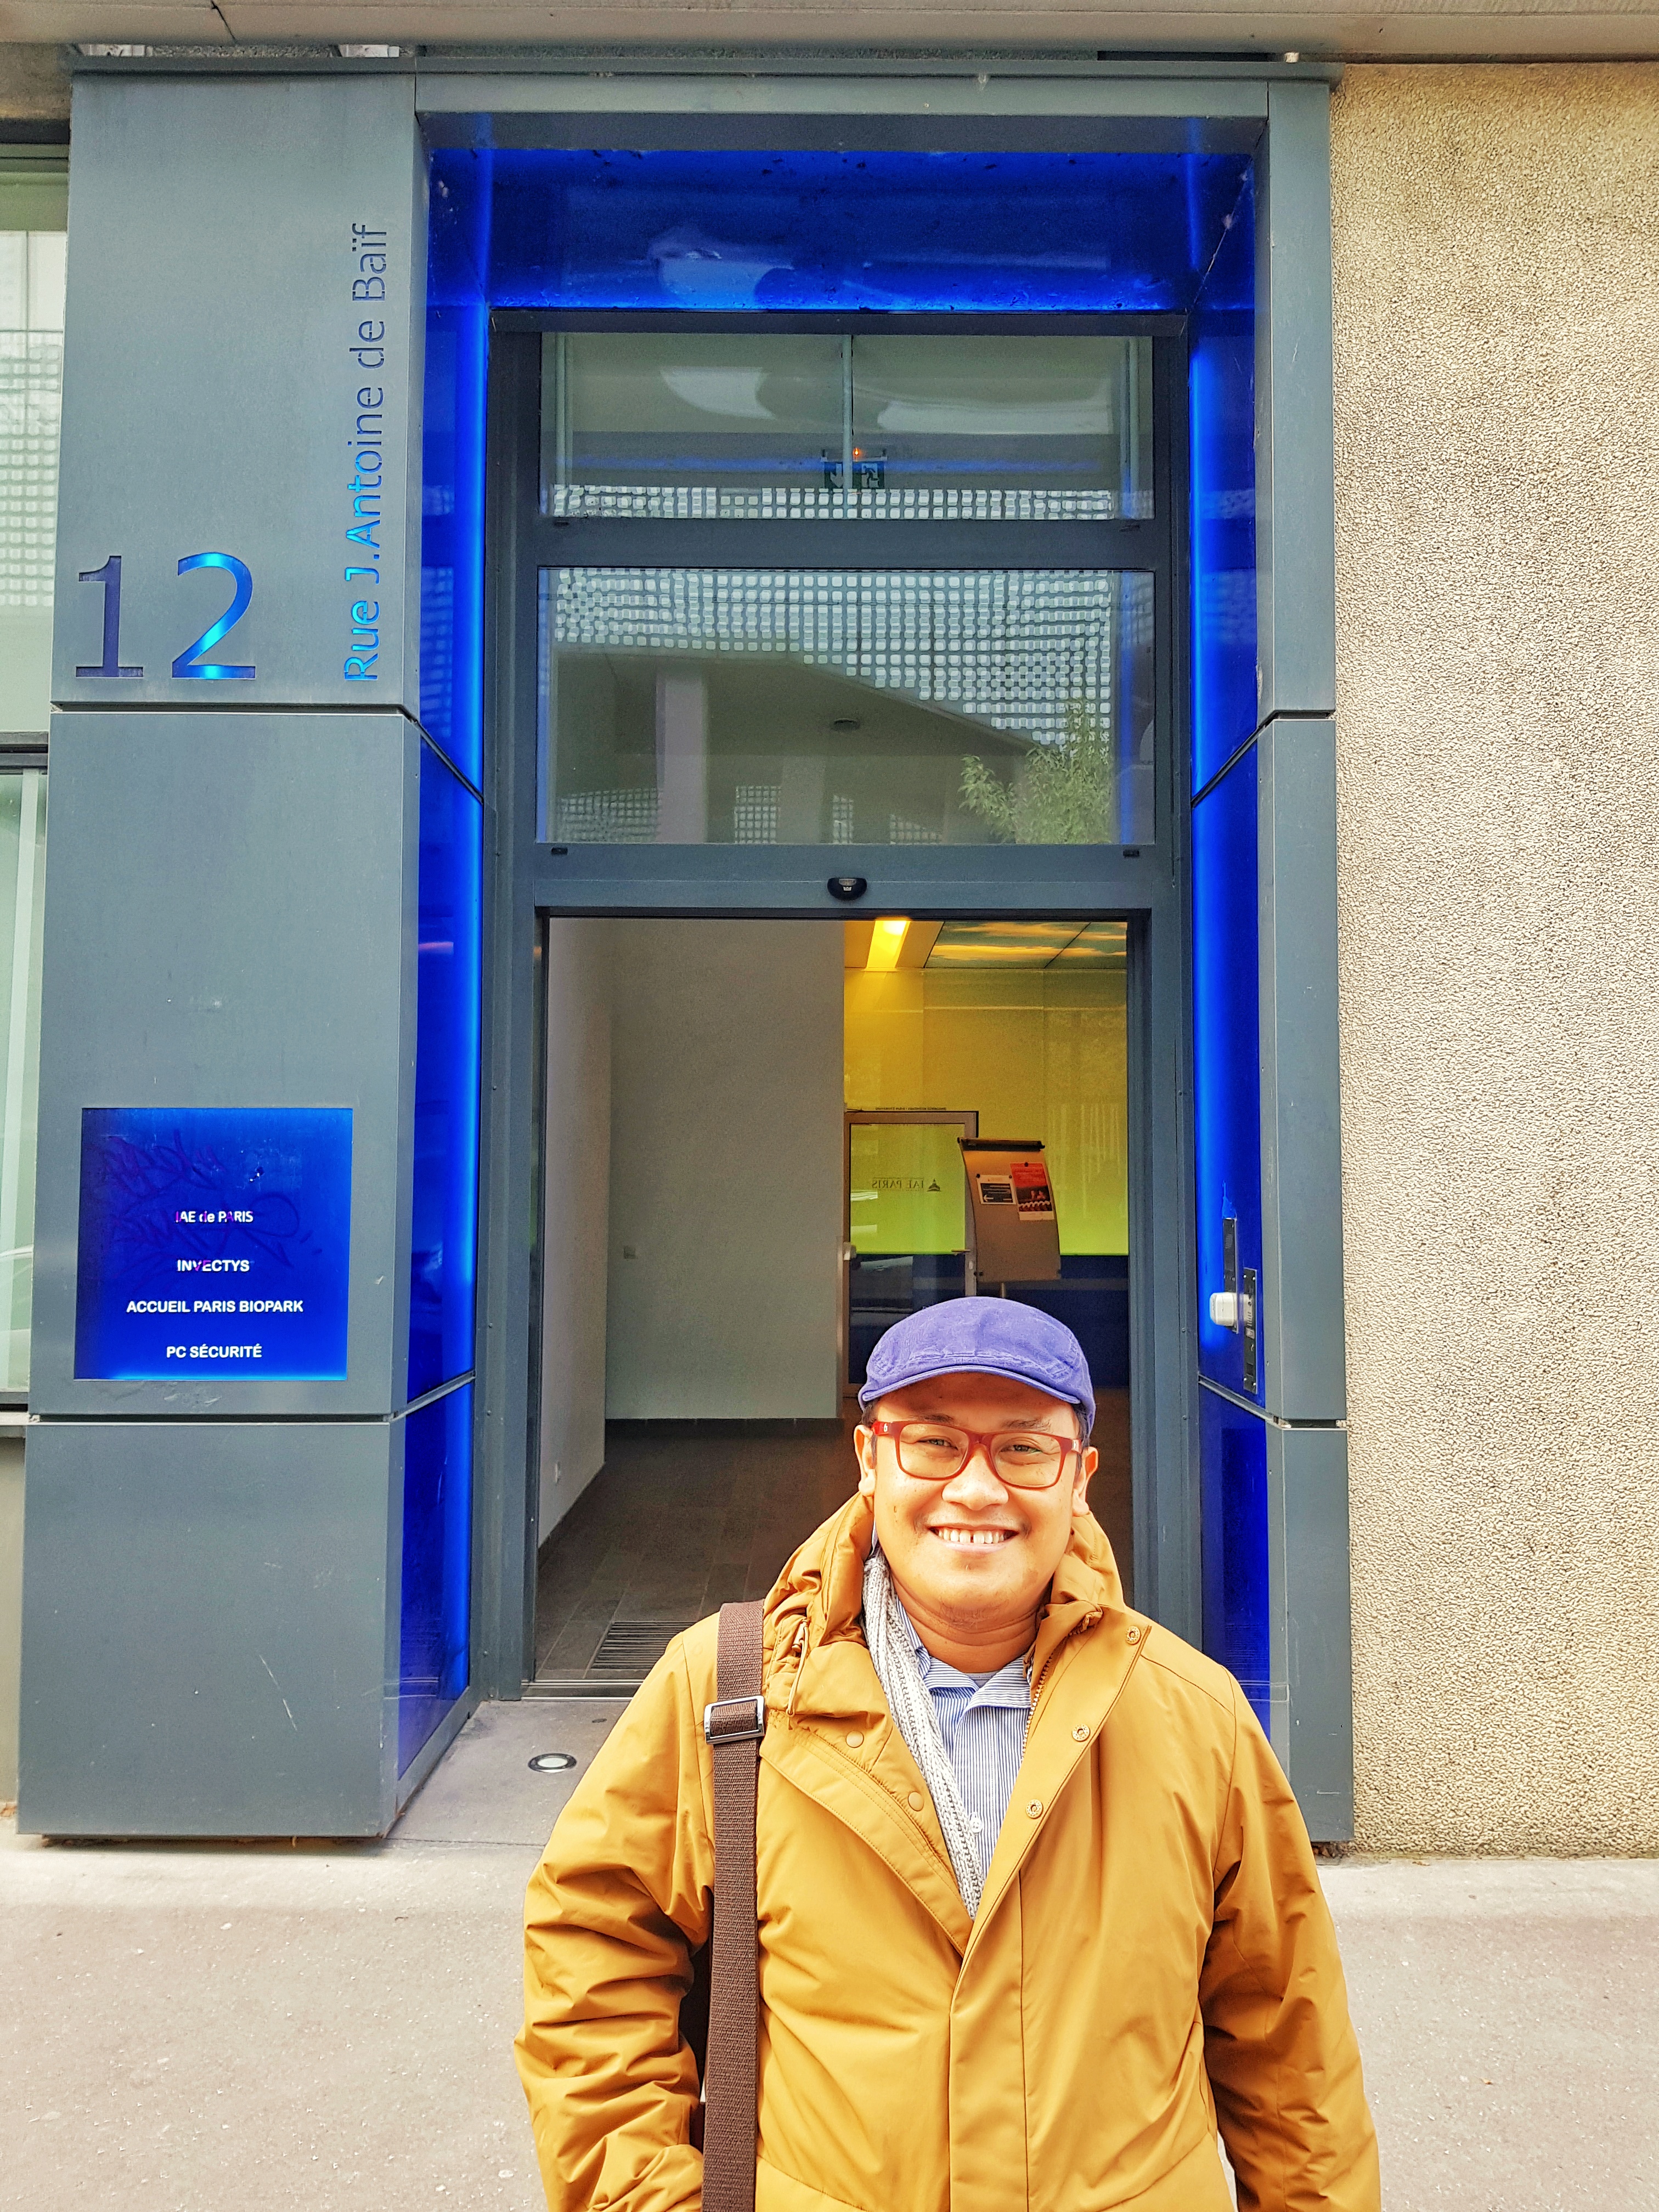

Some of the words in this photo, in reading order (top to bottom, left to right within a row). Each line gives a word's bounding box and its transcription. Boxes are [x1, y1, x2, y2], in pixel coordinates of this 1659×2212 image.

[351, 223, 387, 302] Baïf
[349, 320, 386, 370] de
[75, 552, 256, 680] 12
[344, 601, 380, 682] Rue
[176, 1211, 196, 1223] IAE
[199, 1210, 215, 1222] de
[218, 1211, 253, 1223] PARIS
[177, 1259, 250, 1272] INVECTYS
[126, 1300, 190, 1313] ACCUEIL
[194, 1300, 236, 1313] PARIS
[239, 1300, 303, 1313] BIOPARK
[166, 1346, 187, 1358] PC
[189, 1343, 262, 1358] SÉCURITÉ
